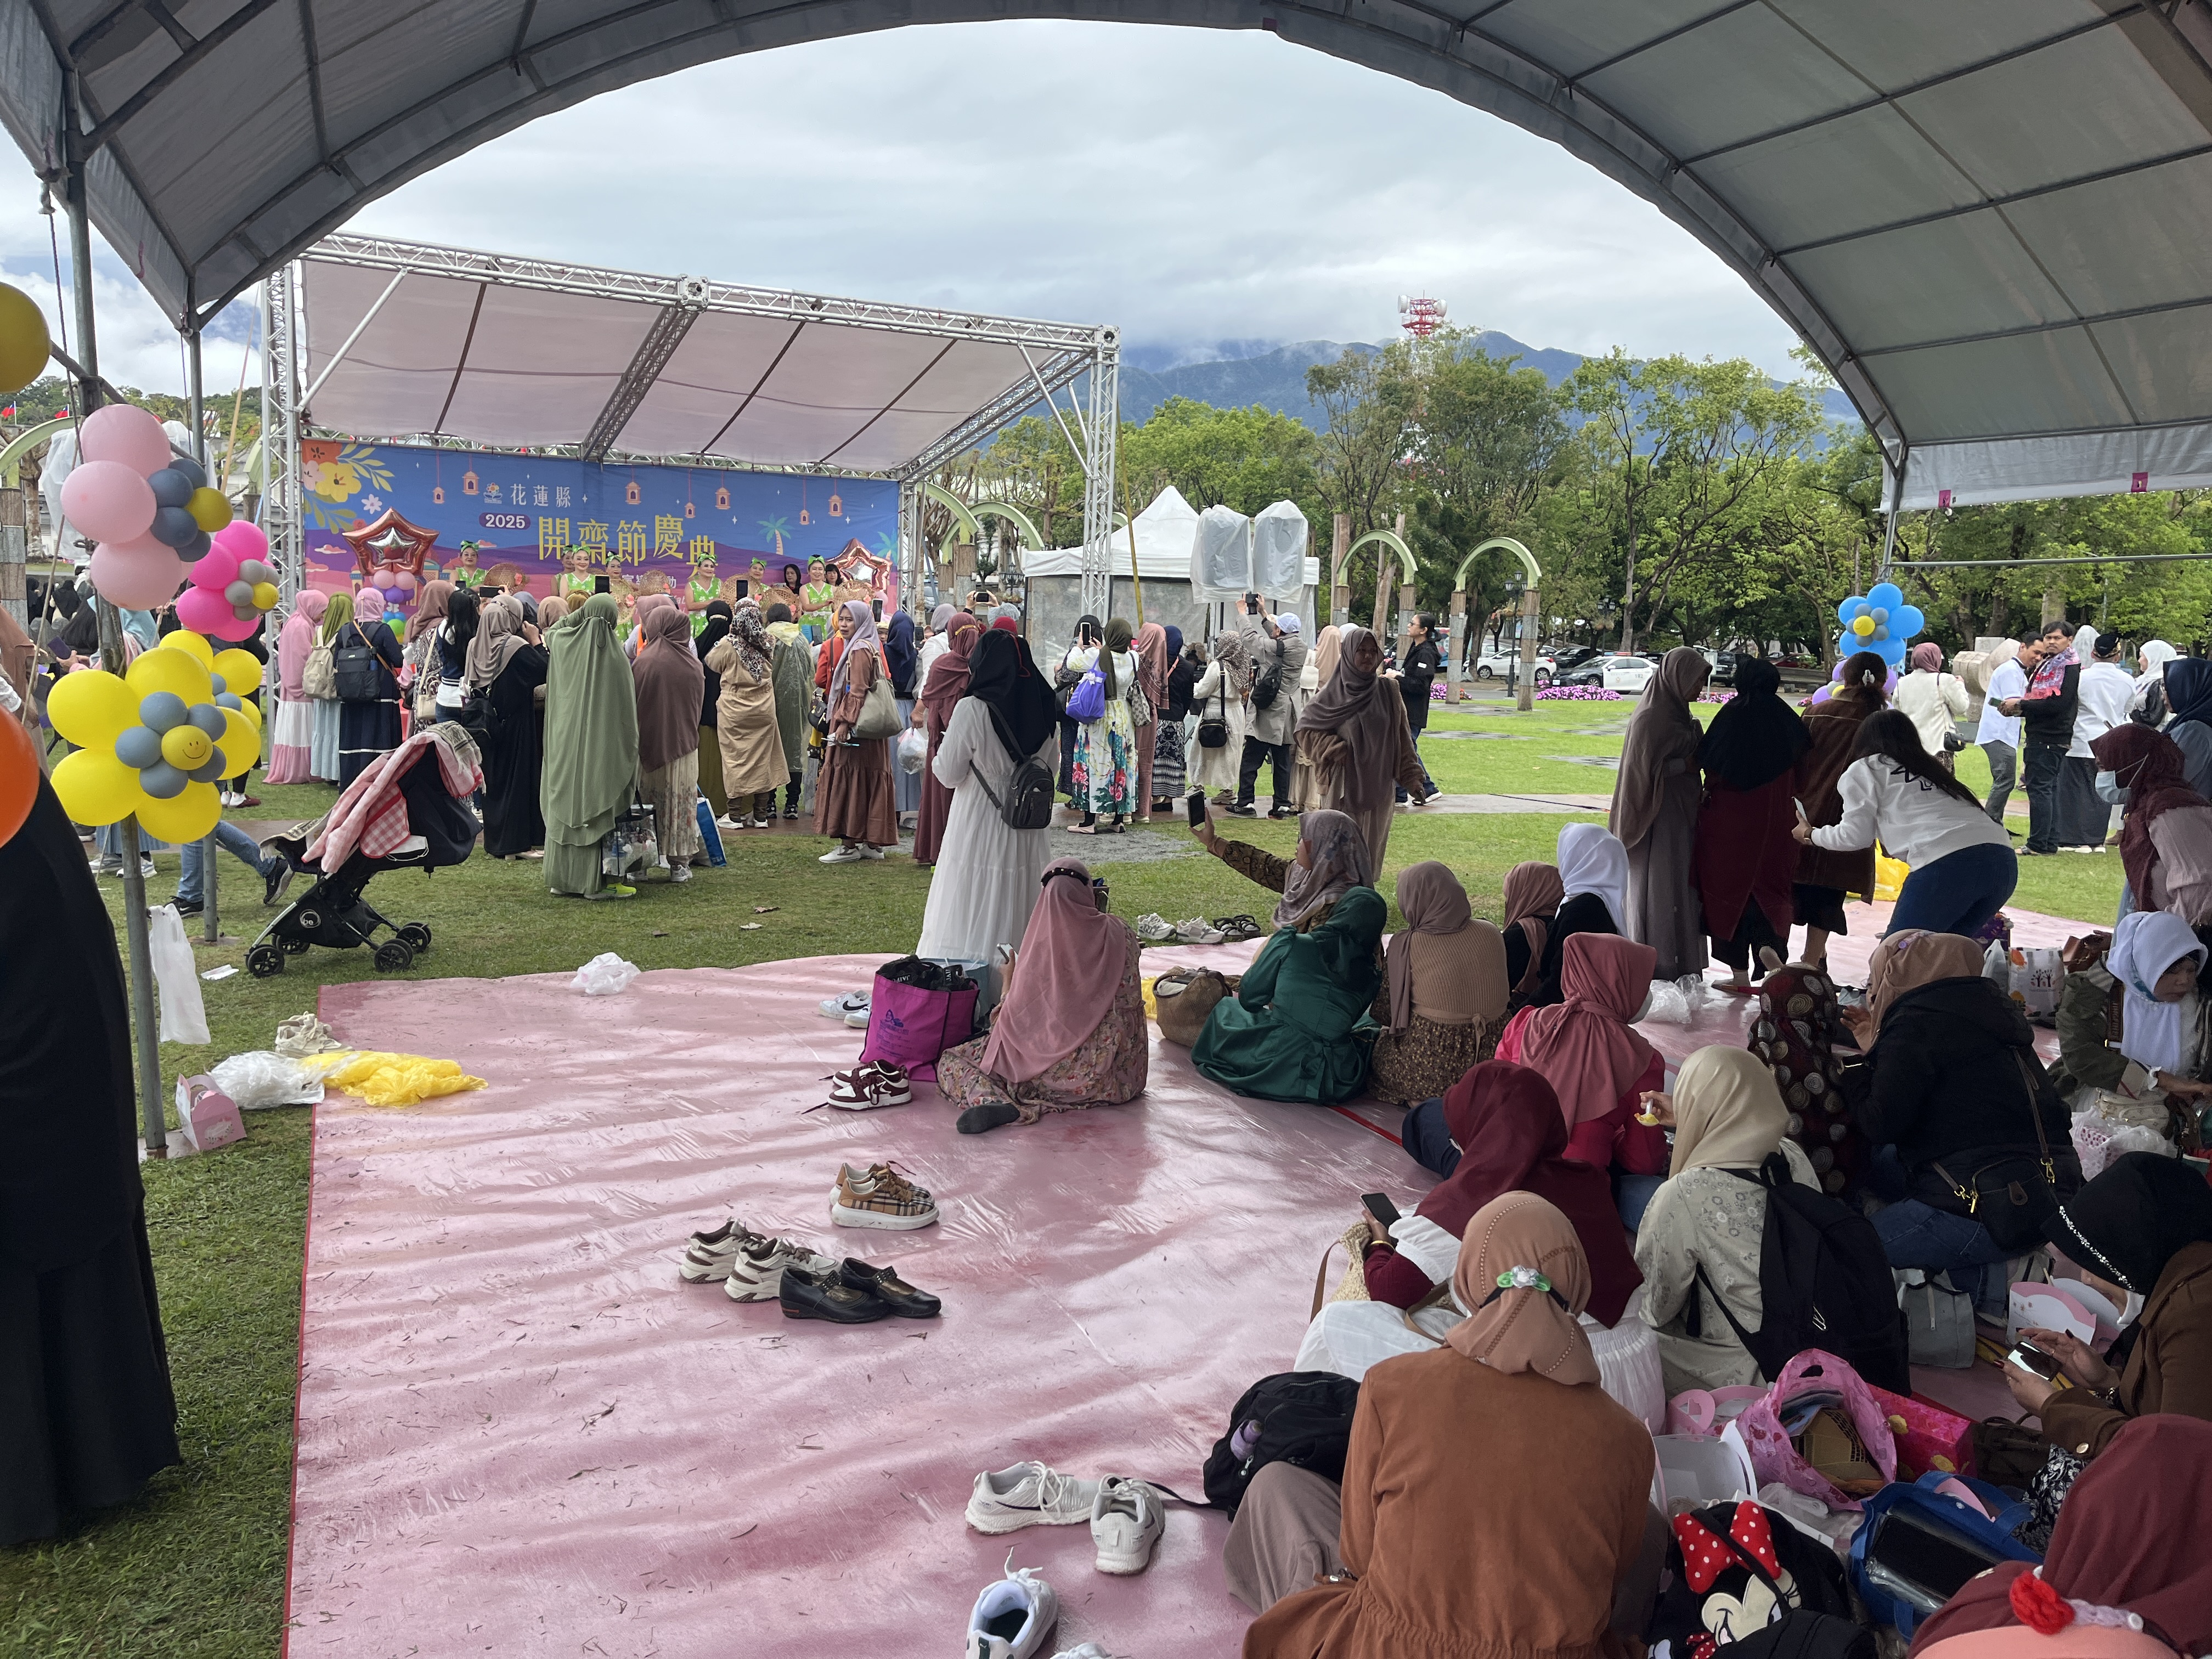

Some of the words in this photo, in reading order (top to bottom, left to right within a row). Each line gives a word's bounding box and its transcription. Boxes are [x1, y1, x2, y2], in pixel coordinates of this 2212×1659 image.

[510, 483, 571, 508] 花蓮縣
[485, 514, 526, 528] 2025
